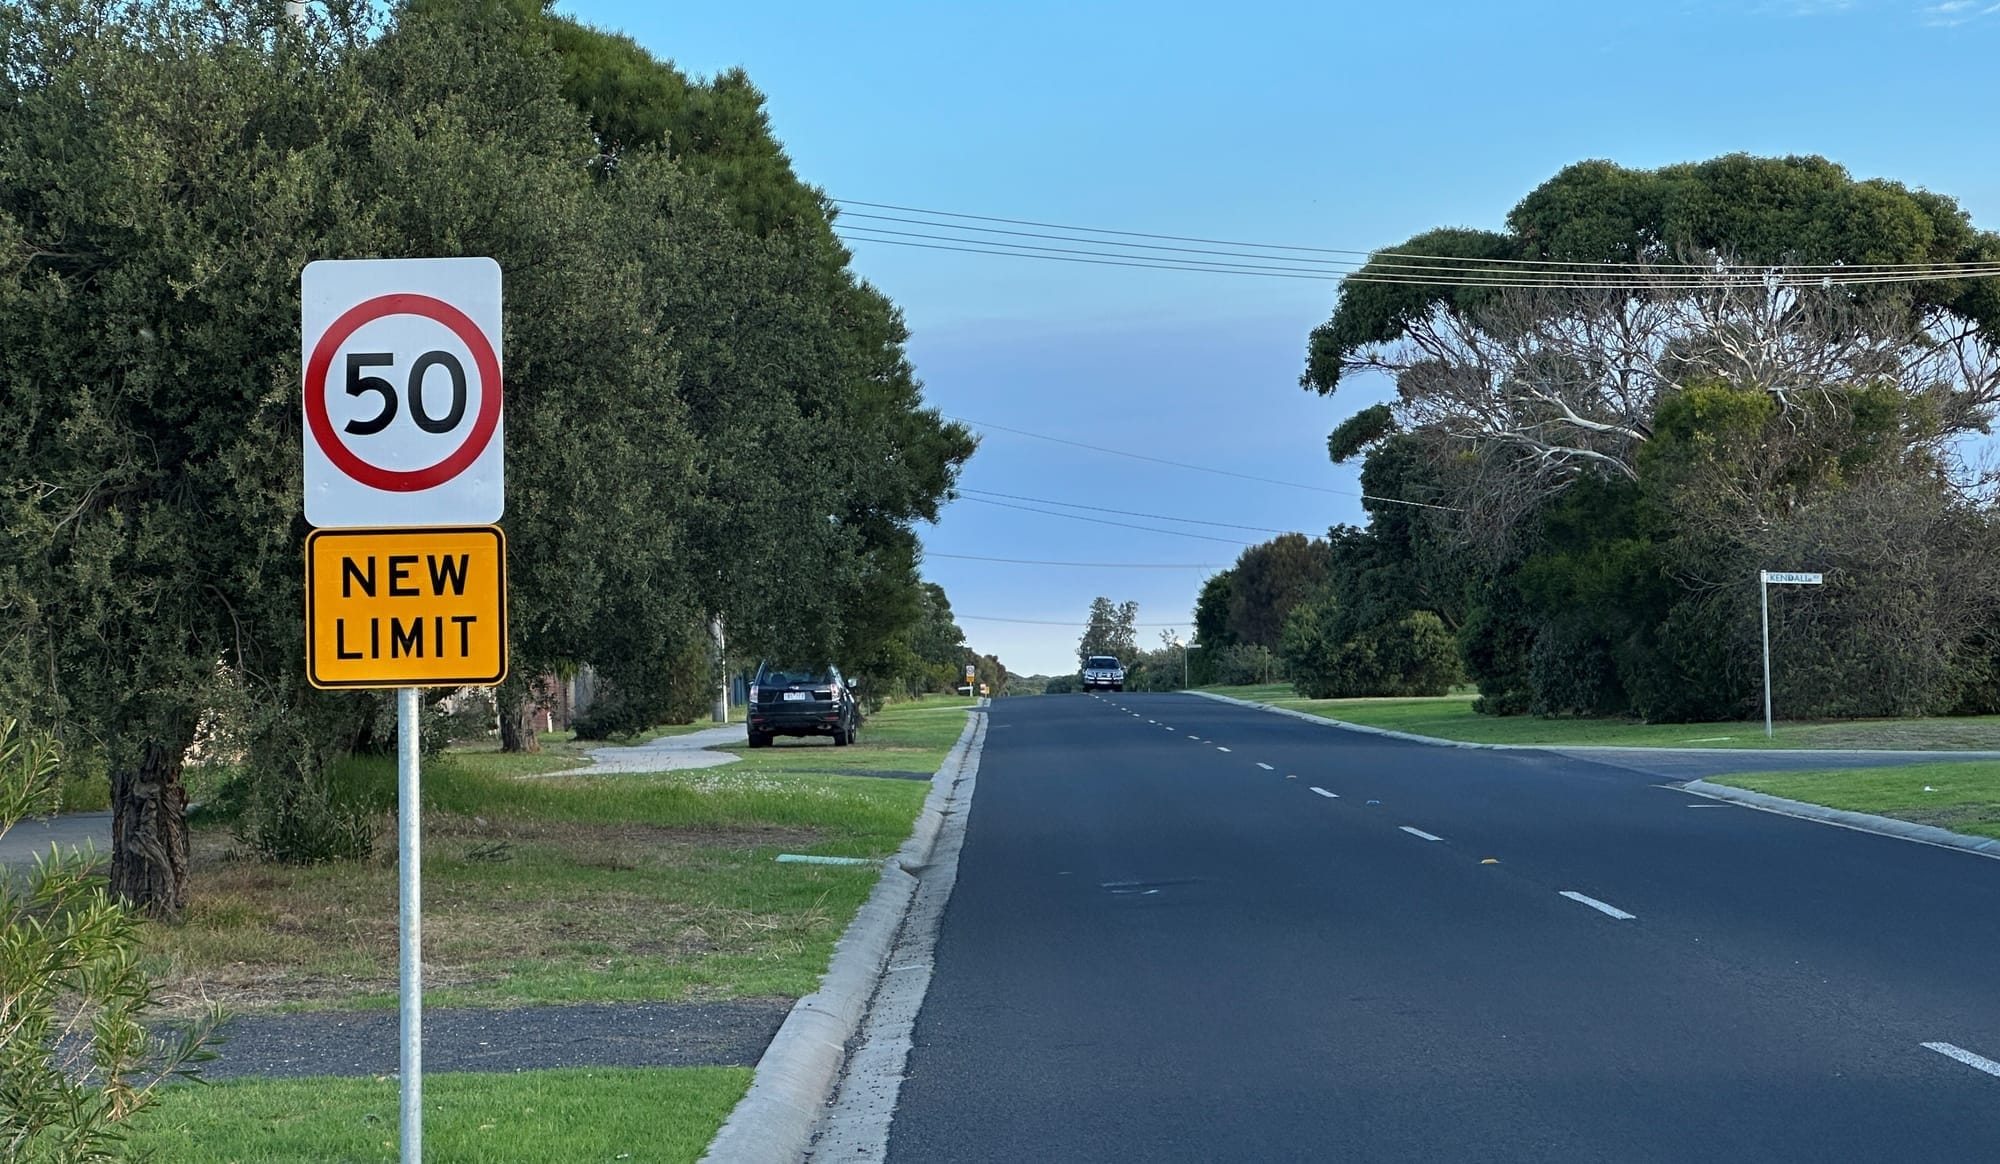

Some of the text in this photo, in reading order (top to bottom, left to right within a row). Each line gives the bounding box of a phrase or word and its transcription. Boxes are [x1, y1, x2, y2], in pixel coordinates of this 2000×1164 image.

[344, 350, 467, 436] 50
[342, 554, 470, 598] NEW
[1769, 574, 1809, 582] KENDALL
[337, 615, 477, 660] LIMIT
